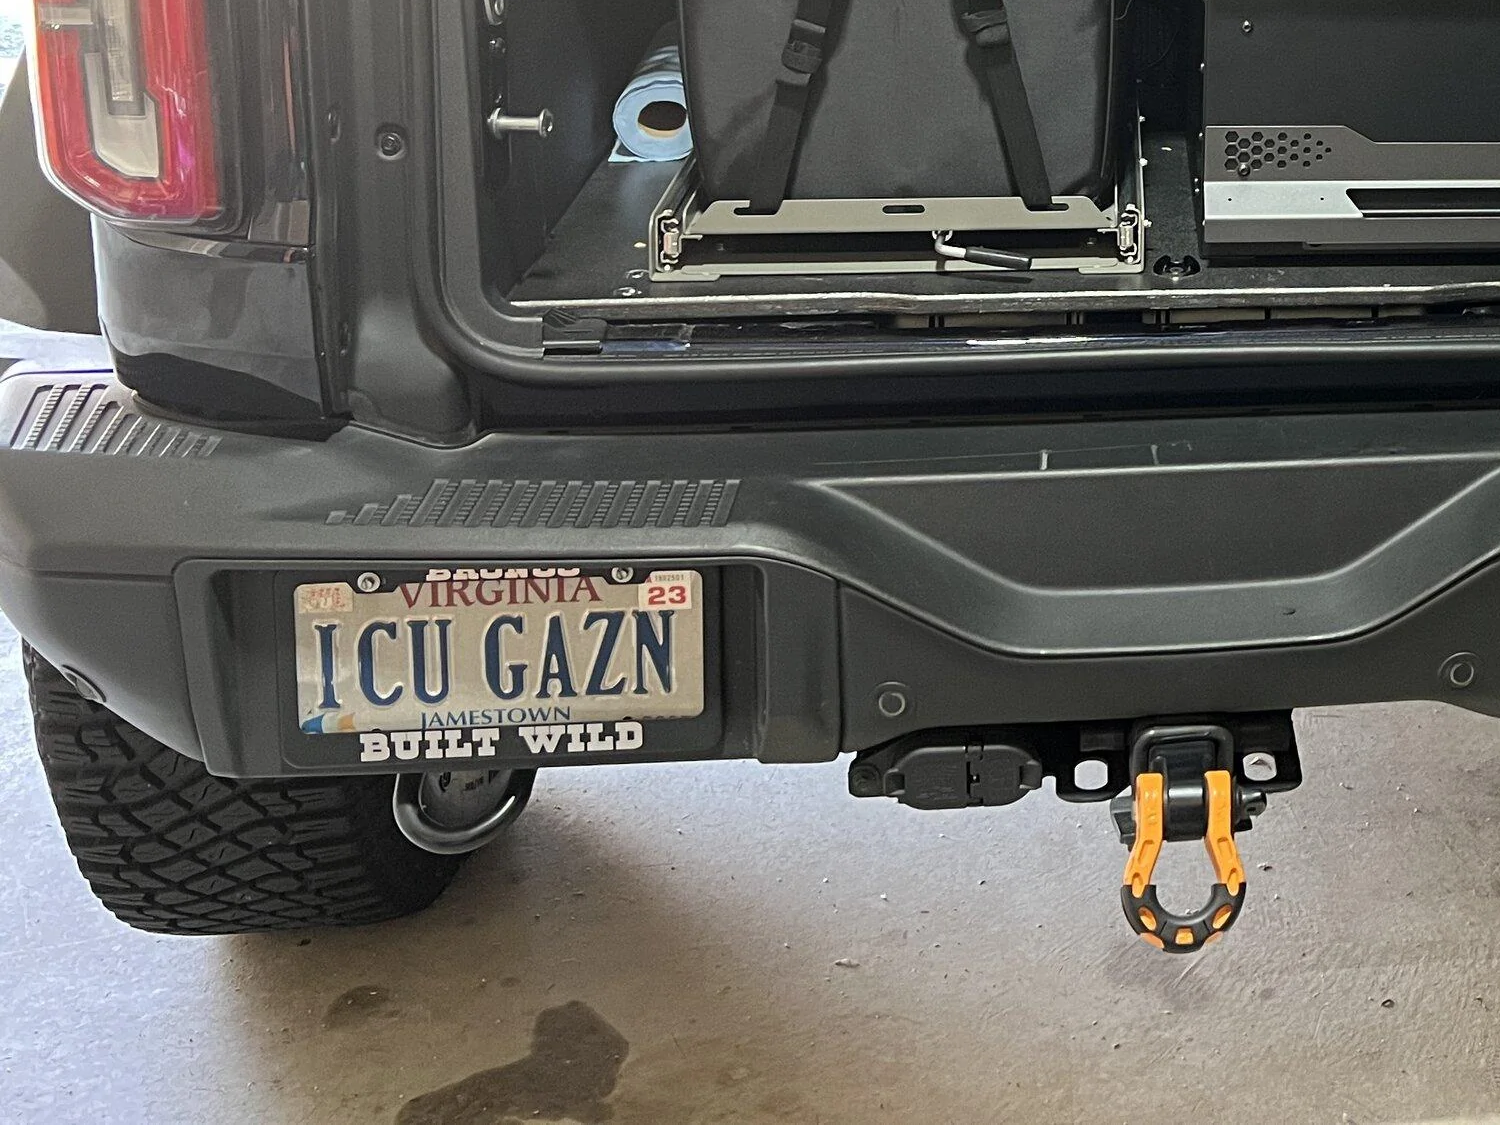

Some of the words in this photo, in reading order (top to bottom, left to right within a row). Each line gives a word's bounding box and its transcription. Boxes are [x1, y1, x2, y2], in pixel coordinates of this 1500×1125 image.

[399, 576, 602, 609] VIRGINIA
[648, 585, 687, 605] 23
[484, 609, 675, 700] GAZN
[421, 706, 571, 730] JAMESTOWN
[359, 729, 499, 762] BUILT
[519, 721, 643, 754] WILD
